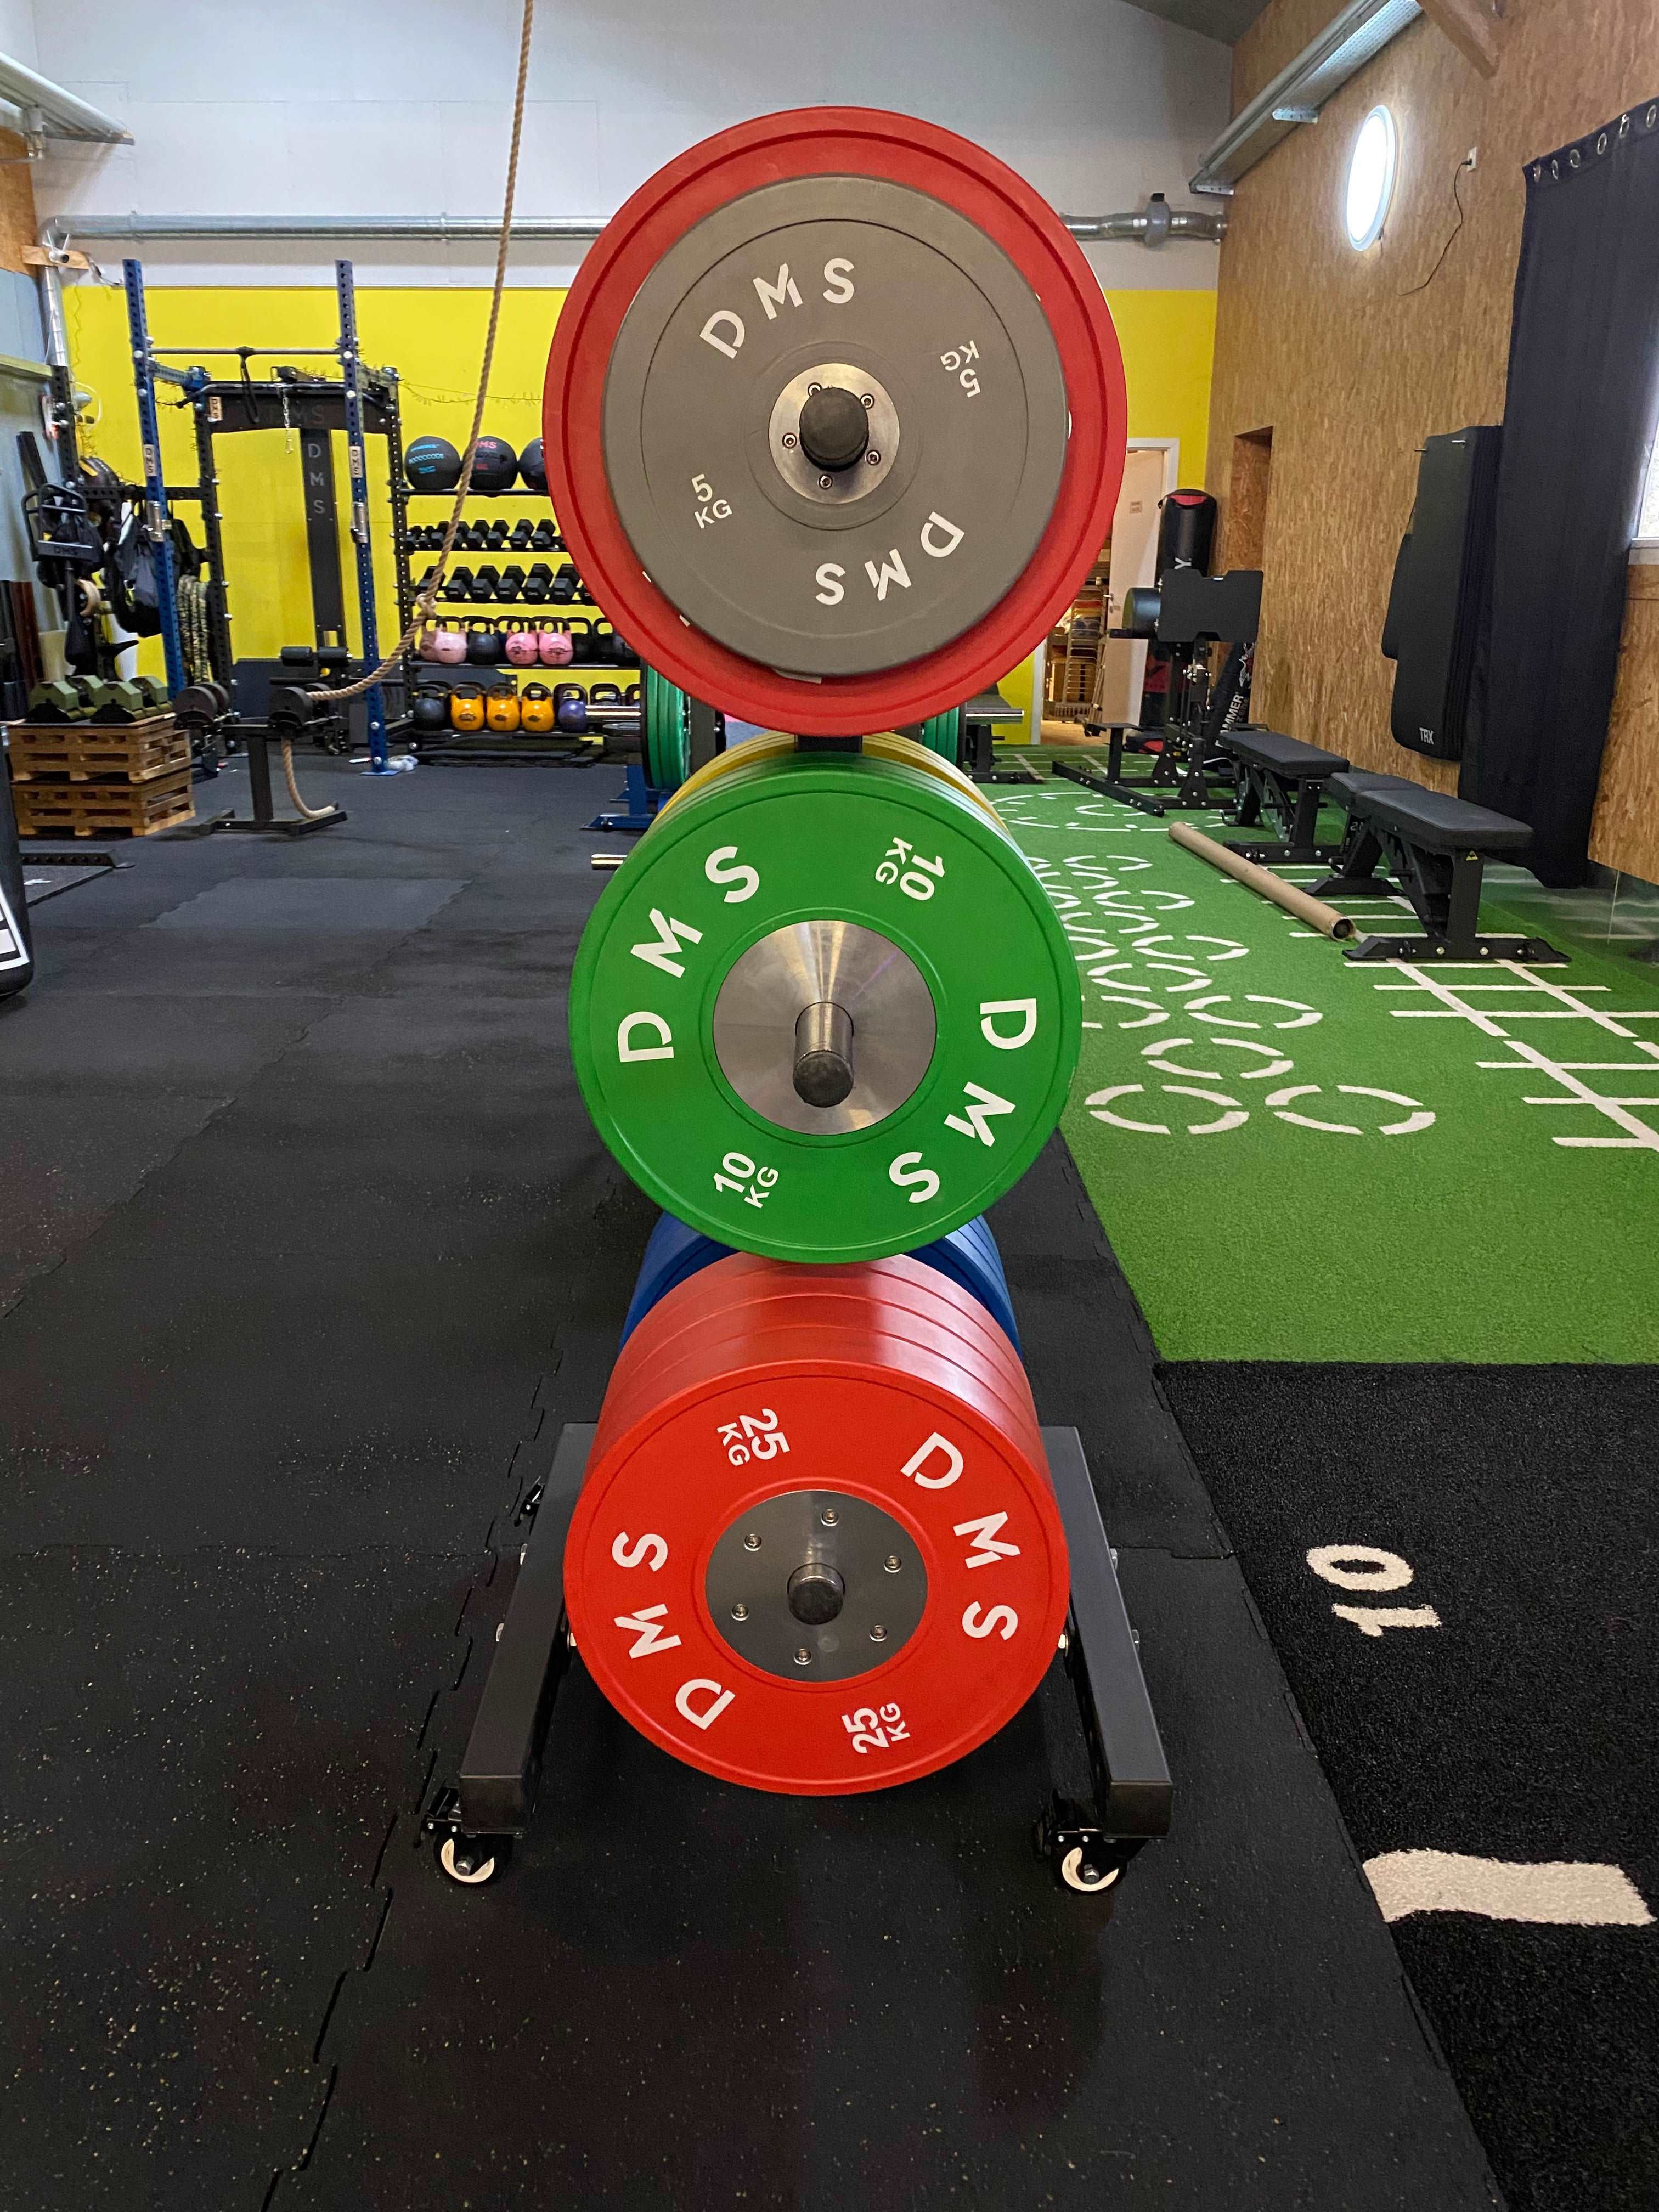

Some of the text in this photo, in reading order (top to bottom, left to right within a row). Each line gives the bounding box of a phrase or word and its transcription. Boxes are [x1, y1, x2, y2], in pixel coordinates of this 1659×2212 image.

[700, 258, 854, 359] DMS
[940, 340, 979, 371] KG
[960, 368, 981, 398] 5
[307, 443, 325, 514] DMS
[691, 473, 713, 502] 5
[695, 499, 732, 529] KG
[815, 511, 965, 605] DMS
[1419, 727, 1434, 745] TRX
[875, 837, 913, 885] KG
[900, 855, 945, 901] 10
[617, 845, 760, 1063] DMS
[890, 998, 1037, 1203] DMS
[713, 1152, 755, 1193] 10
[744, 1166, 778, 1209] KG
[717, 1423, 750, 1466] KG
[739, 1408, 790, 1460] 25
[900, 1432, 1020, 1641] DMS
[1306, 1543, 1442, 1638] 10
[612, 1531, 735, 1730] DMS
[842, 1708, 889, 1754] 25
[879, 1703, 911, 1742] KG
